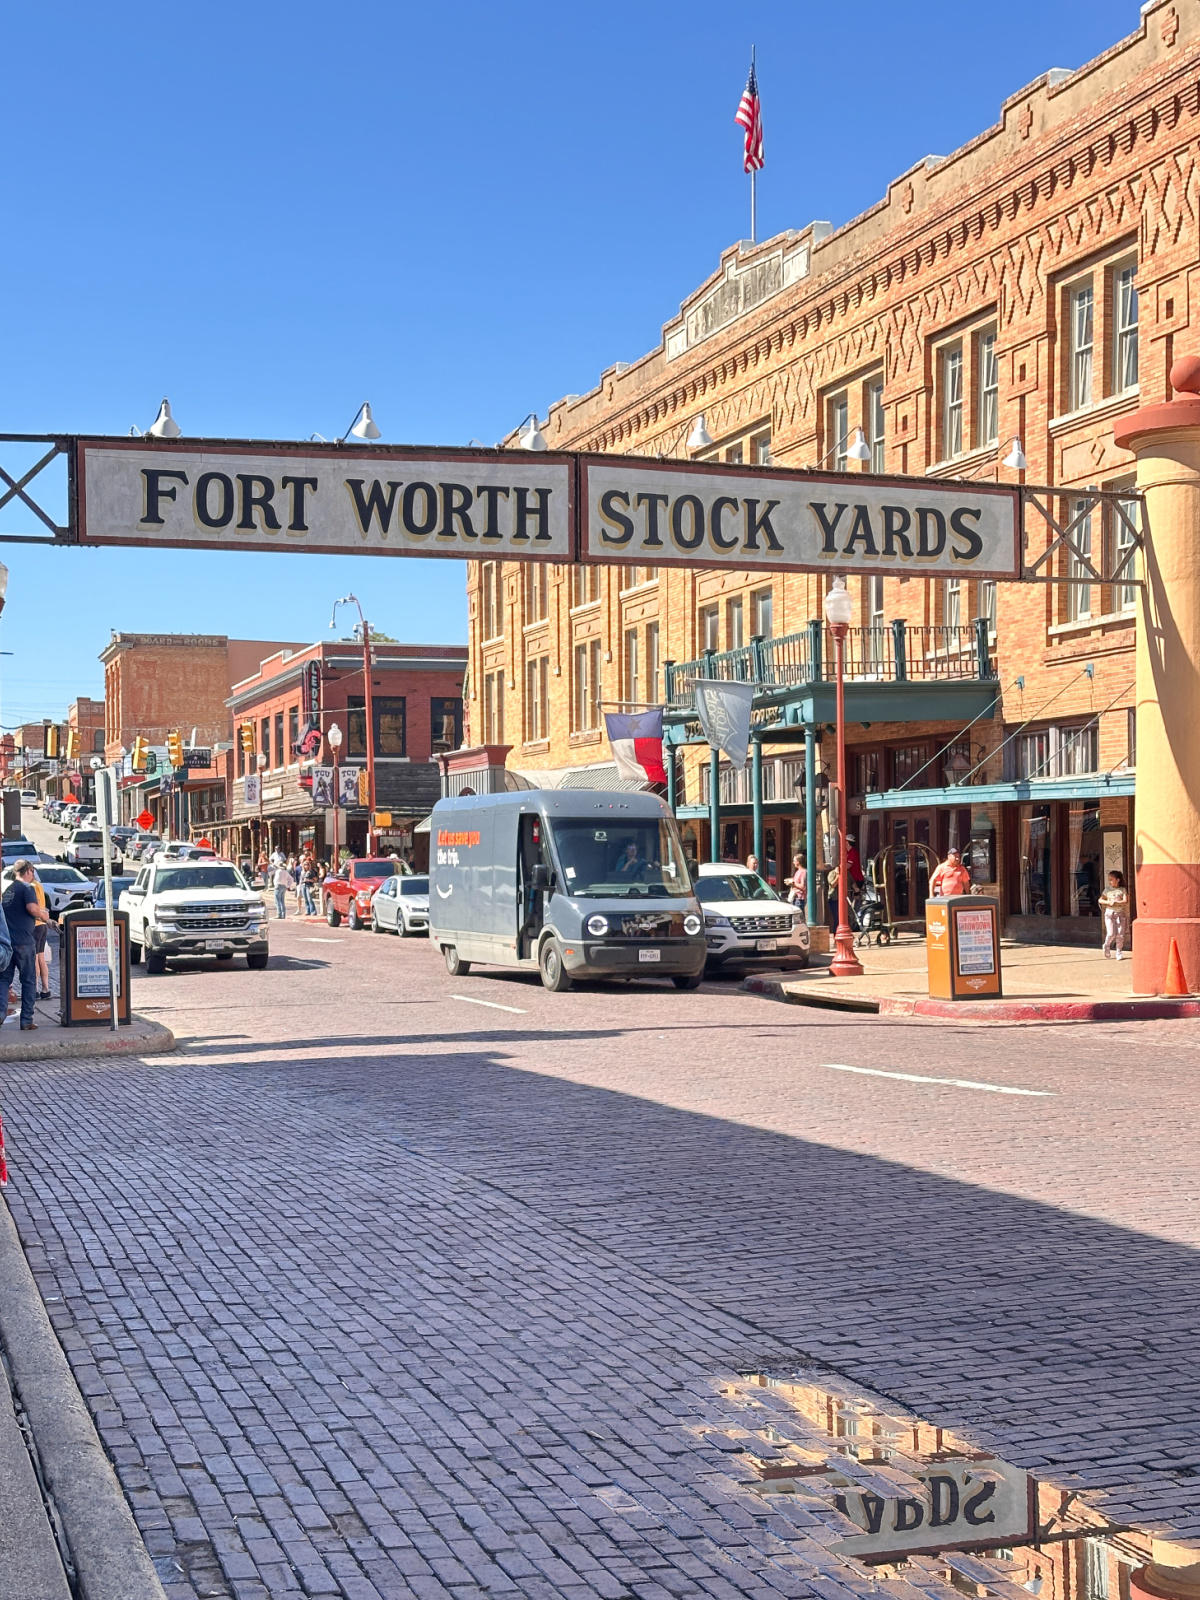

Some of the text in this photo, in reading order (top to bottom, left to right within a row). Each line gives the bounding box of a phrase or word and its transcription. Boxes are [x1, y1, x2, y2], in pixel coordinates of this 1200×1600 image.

[137, 468, 983, 565] FORT WORTH STOCK YARDS
[140, 637, 172, 646] BOARD
[184, 638, 219, 647] ROOMS
[314, 770, 330, 778] TCU
[341, 770, 357, 778] TCU
[437, 829, 481, 848] Let us save you
[437, 848, 460, 867] the trip.
[78, 938, 118, 948] THROWDON
